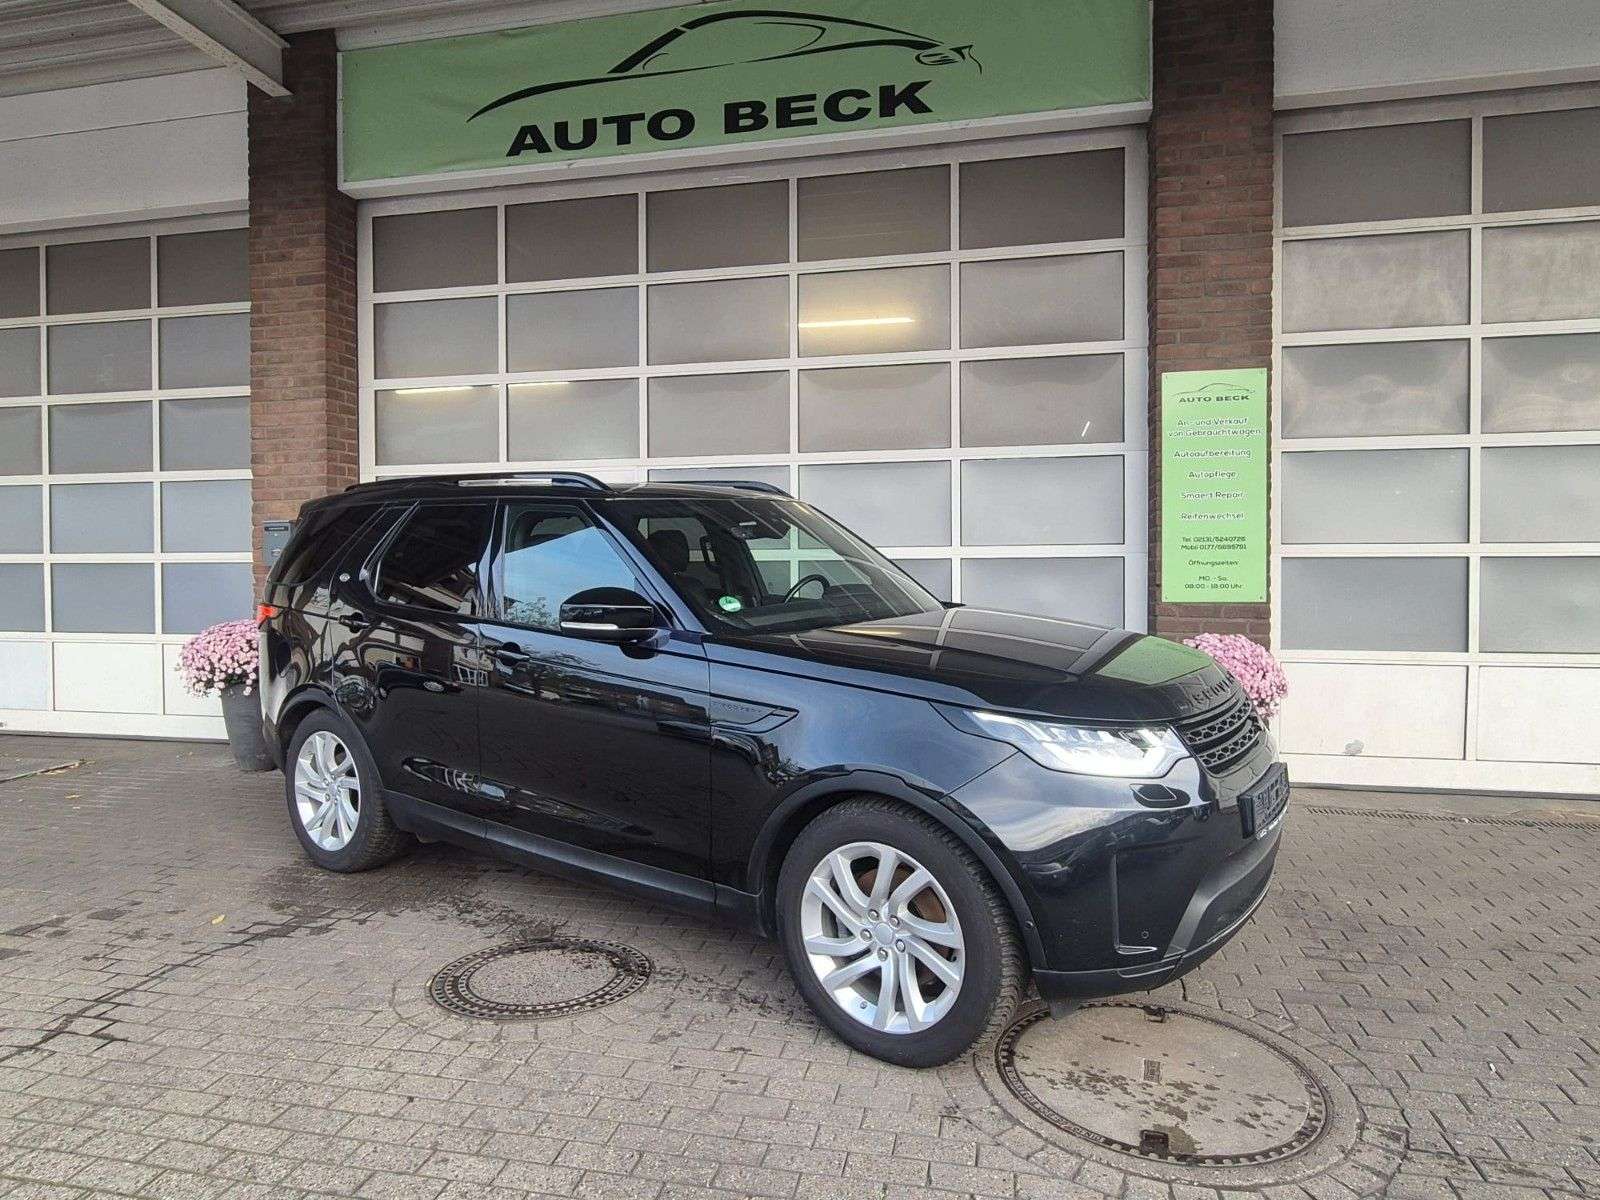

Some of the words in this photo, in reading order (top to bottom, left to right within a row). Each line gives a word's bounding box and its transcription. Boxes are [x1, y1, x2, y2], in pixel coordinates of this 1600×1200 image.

[506, 109, 695, 157] AUTO
[724, 80, 934, 135] BECK
[1195, 418, 1212, 426] und
[1214, 417, 1248, 426] Verkauf
[1185, 429, 1261, 437] Gebrauchtwagen
[1173, 449, 1251, 458] Autoaufbereitung
[1189, 471, 1236, 479] Autopflege
[1181, 512, 1244, 520] Reifenwechsel
